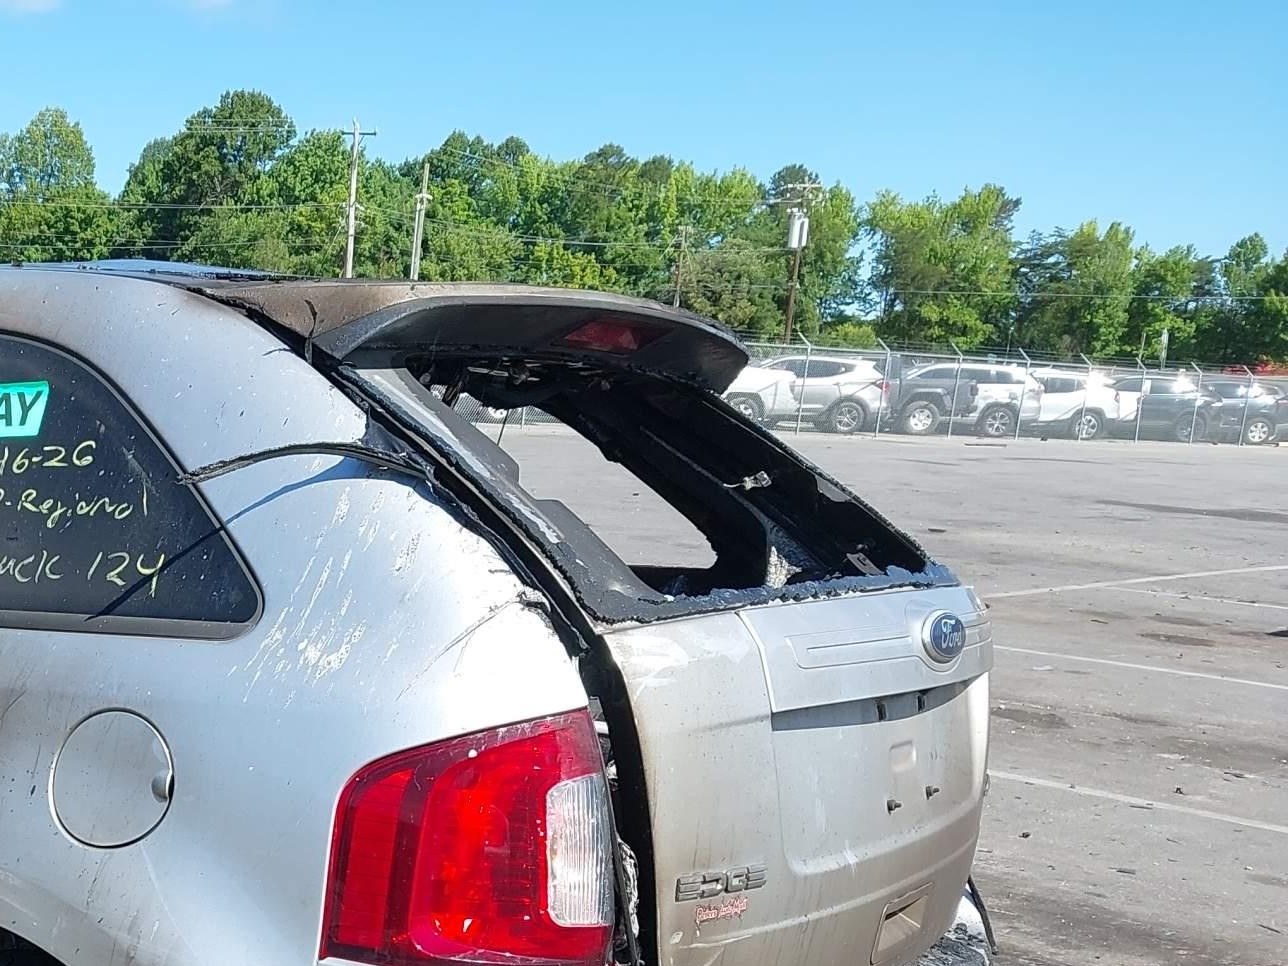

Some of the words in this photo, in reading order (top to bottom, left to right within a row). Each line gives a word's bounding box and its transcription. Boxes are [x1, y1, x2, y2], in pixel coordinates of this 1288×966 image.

[87, 551, 165, 599] 124
[940, 618, 962, 649] Ford
[675, 864, 768, 903] EDGE
